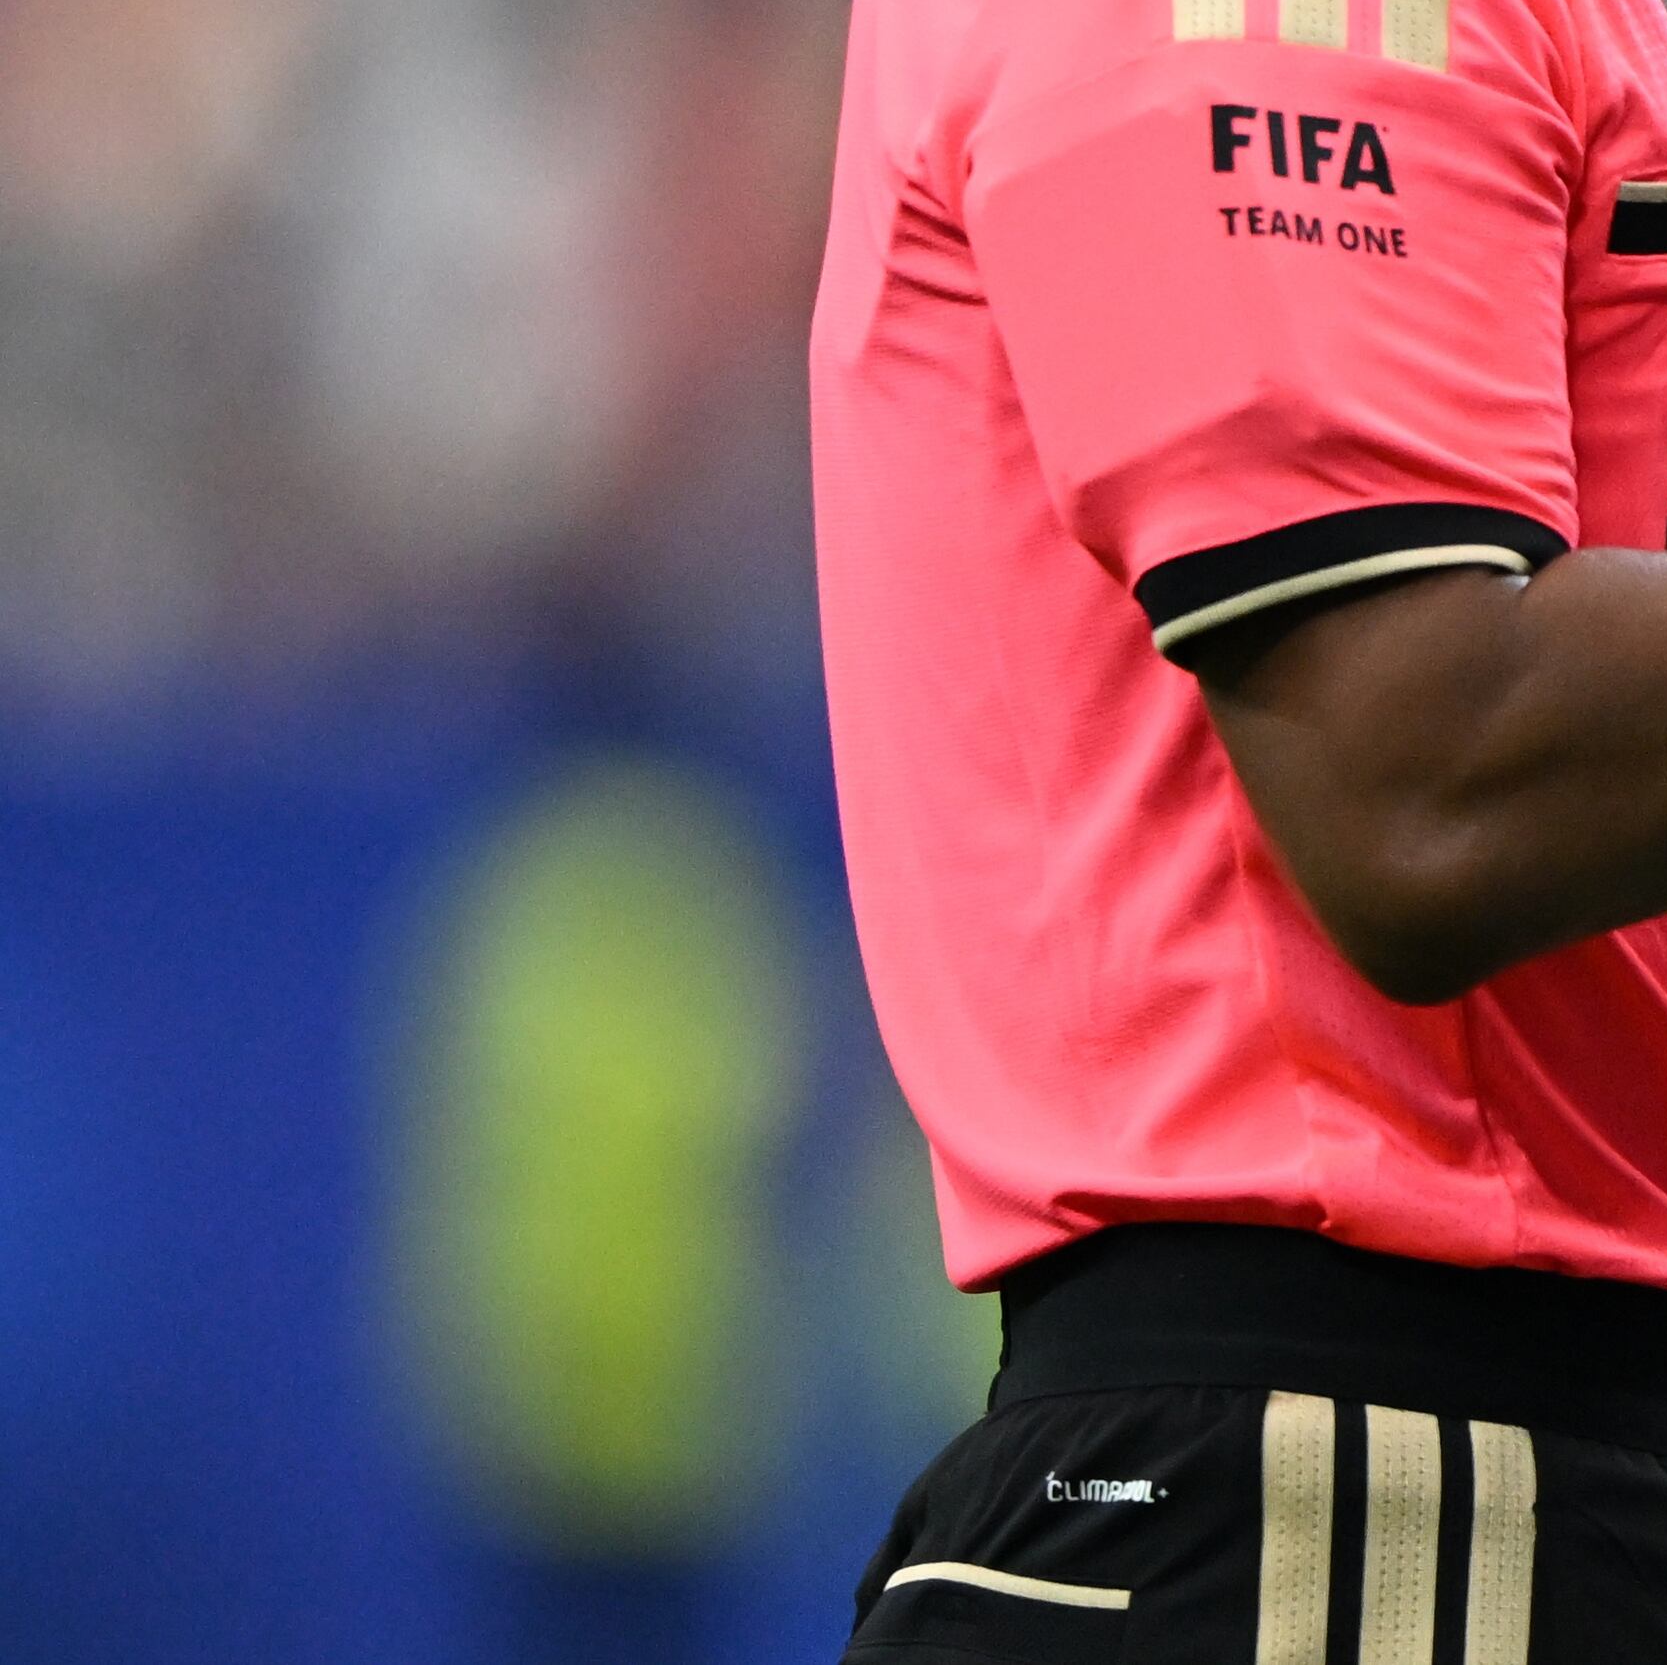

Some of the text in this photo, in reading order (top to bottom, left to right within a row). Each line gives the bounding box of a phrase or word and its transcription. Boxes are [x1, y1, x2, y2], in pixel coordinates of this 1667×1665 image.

[1210, 103, 1396, 196] FIFA
[1219, 206, 1408, 259] TEAM ONE
